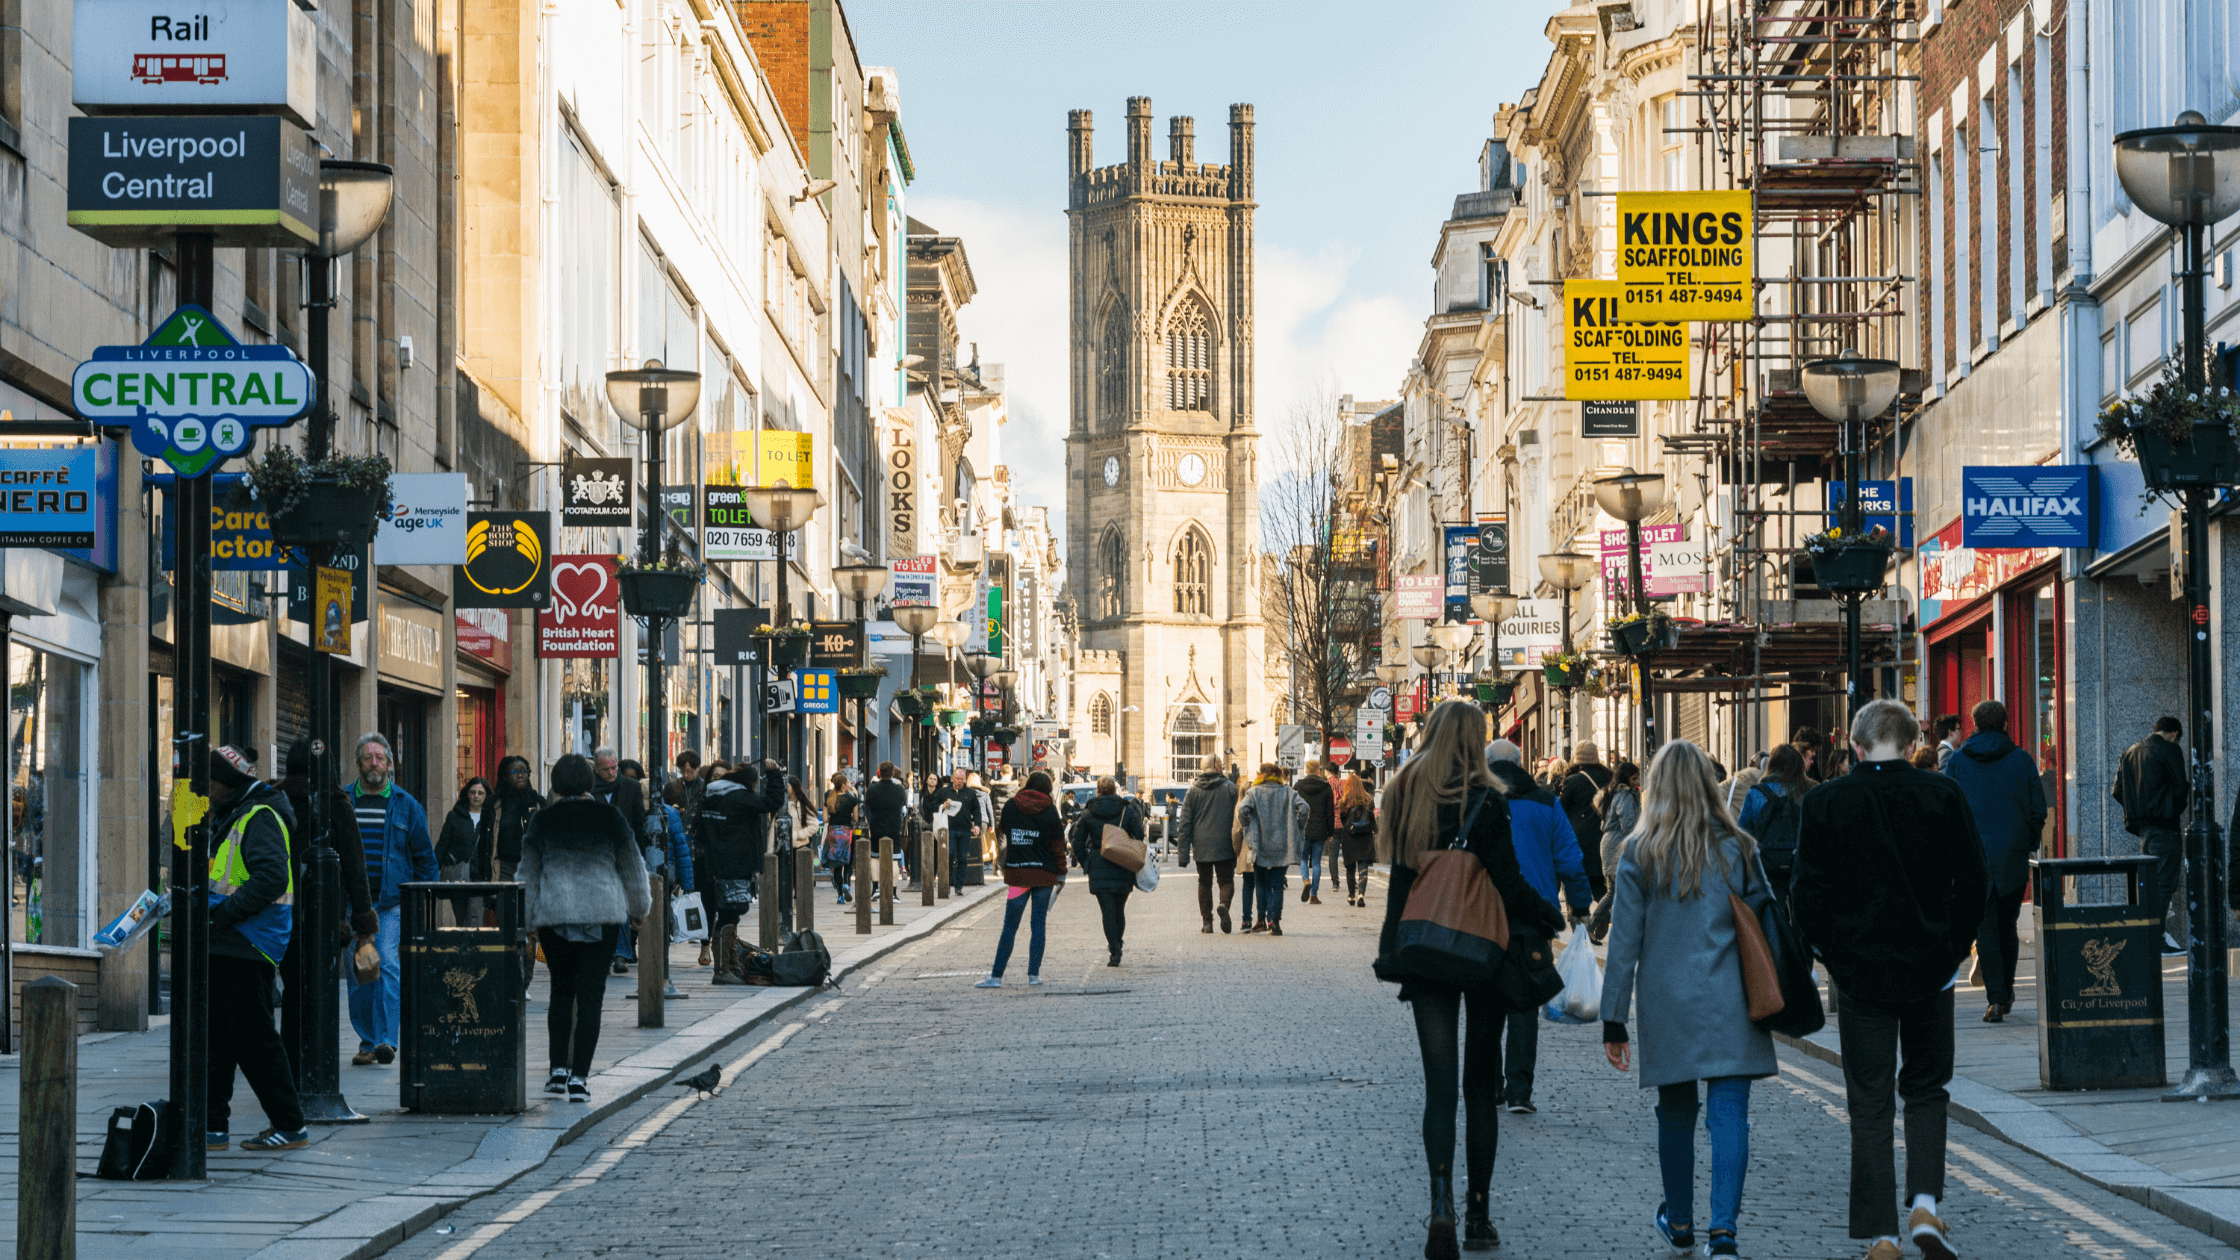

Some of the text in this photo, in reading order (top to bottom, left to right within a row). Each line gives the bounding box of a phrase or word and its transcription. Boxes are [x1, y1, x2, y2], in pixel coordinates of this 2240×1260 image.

[150, 15, 208, 41] Rail
[103, 131, 245, 163] Liverpool
[286, 137, 315, 176] Liverpool
[102, 172, 213, 199] Central
[286, 177, 308, 214] Central
[1624, 211, 1743, 245] KINGS
[1624, 248, 1743, 267] SCAFFOLDING
[1666, 272, 1701, 286] TEL.
[1626, 288, 1743, 303] 0151 487-9494
[1574, 330, 1683, 347] SCAFFOLDING
[126, 350, 250, 360] LIVERPOOL
[1612, 352, 1645, 365] TEL.
[1575, 368, 1683, 381] 0151 487-9494
[83, 372, 298, 406] CENTRAL
[1586, 406, 1635, 415] CHANDLER
[767, 450, 811, 463] TO LET
[0, 465, 70, 485] CAFFÈ
[891, 428, 913, 533] LOOKS
[1859, 487, 1879, 498] HE
[415, 507, 460, 517] Merseyside
[1967, 496, 2083, 517] HALIFAX
[709, 509, 751, 524] TO LET
[395, 518, 443, 533] age UK
[2, 536, 35, 544] ITALIAN
[39, 536, 72, 544] COFFEE
[707, 531, 795, 548] 020 7659 488
[1655, 528, 1677, 542] LET
[897, 562, 929, 572] TO LET
[1398, 576, 1440, 587] TO LET
[896, 587, 923, 596] Matthews
[901, 593, 930, 601] Goodman
[1023, 577, 1031, 639] TATTOO
[1512, 605, 1538, 619] ALL
[543, 627, 615, 638] British Heart
[1499, 620, 1561, 636] NQUIRIES
[543, 639, 615, 651] Foundation
[824, 634, 844, 652] KO
[2061, 997, 2147, 1011] City of Liverpool
